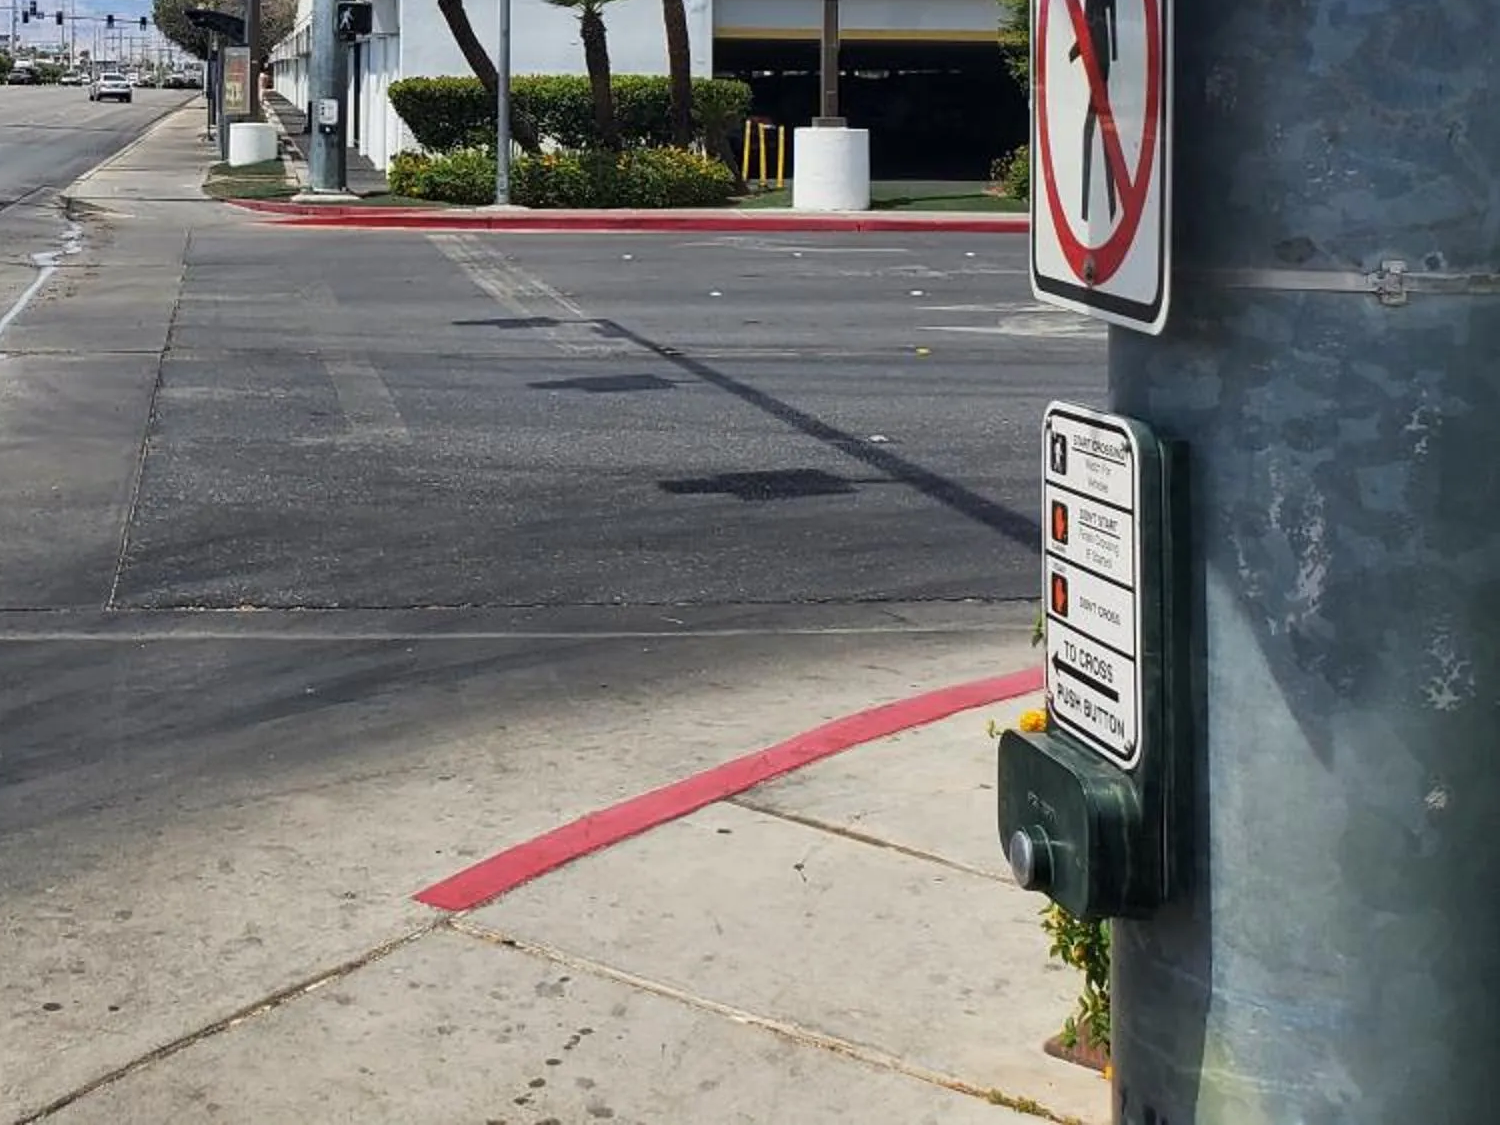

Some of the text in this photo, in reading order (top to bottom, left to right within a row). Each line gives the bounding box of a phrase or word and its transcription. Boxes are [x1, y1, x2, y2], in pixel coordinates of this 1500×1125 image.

[1063, 640, 1114, 683] TO CROSS
[1057, 683, 1125, 739] PUSH BUTTON
